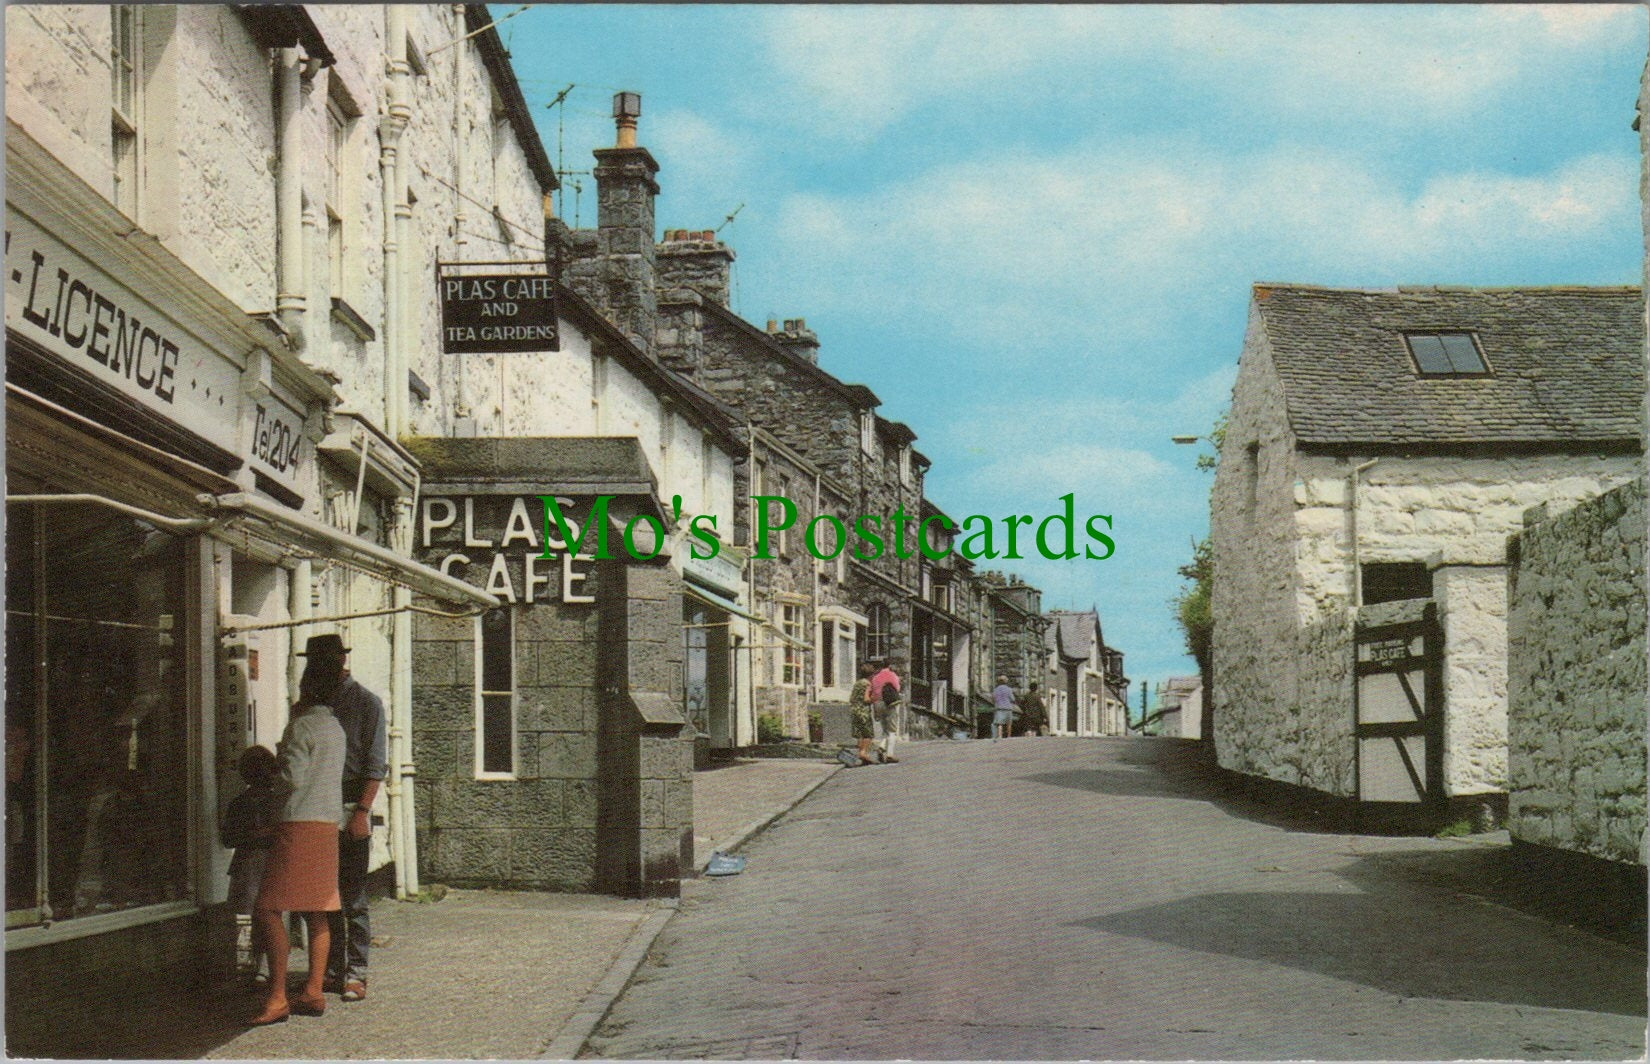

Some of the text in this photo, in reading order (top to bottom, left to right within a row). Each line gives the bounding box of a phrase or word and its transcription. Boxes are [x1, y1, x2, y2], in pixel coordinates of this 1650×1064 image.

[446, 278, 553, 301] PLAS CAFE
[481, 302, 518, 317] AND
[447, 325, 555, 342] TEA GARDENS
[270, 420, 302, 480] 204
[422, 498, 581, 549] PLAS
